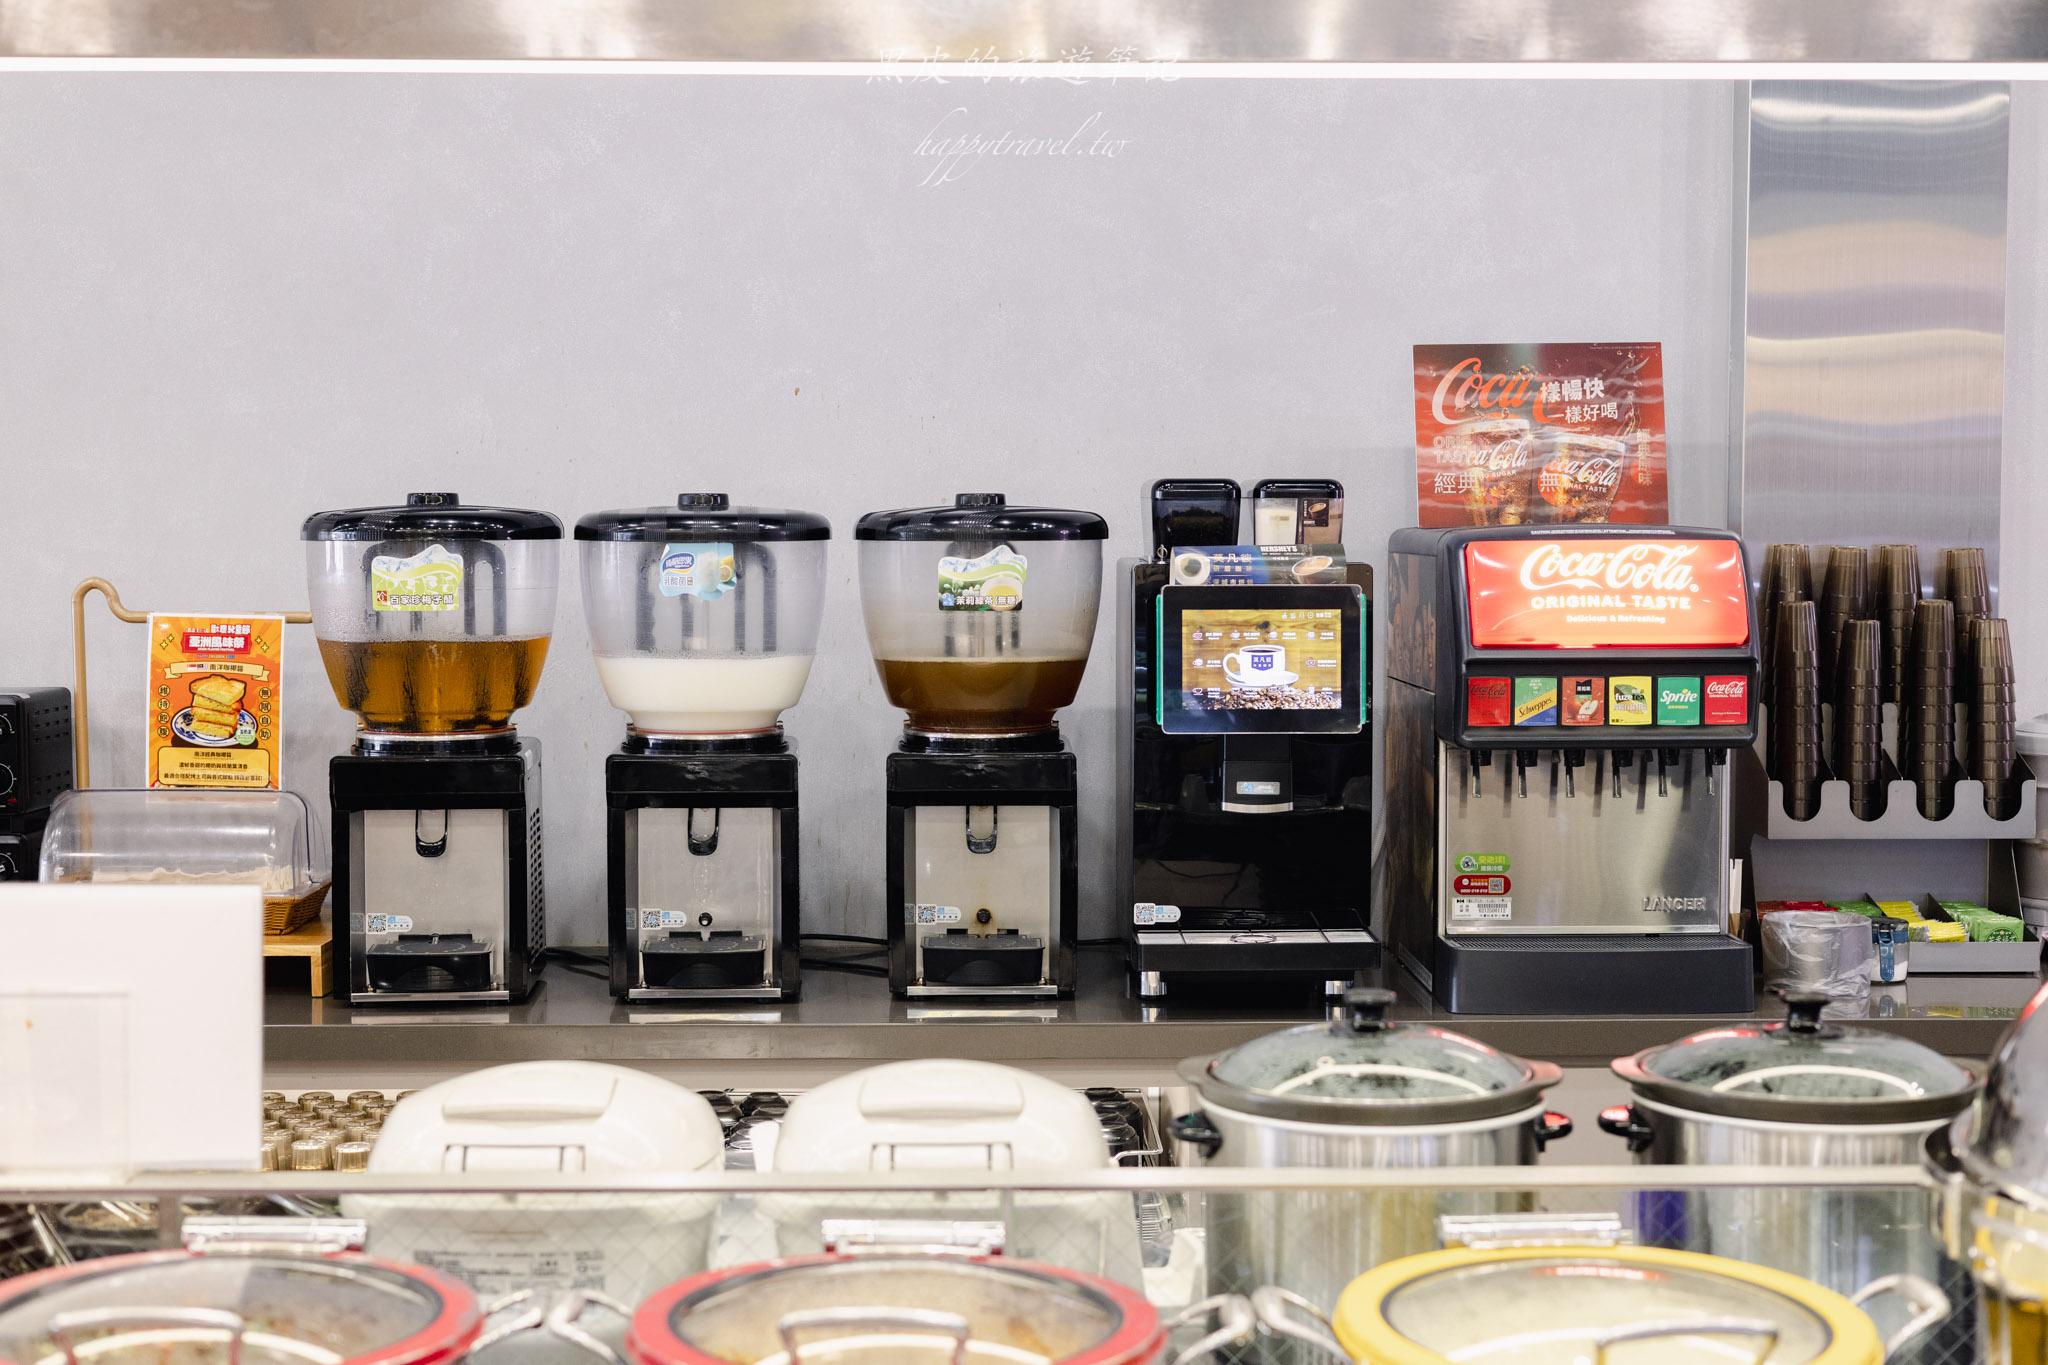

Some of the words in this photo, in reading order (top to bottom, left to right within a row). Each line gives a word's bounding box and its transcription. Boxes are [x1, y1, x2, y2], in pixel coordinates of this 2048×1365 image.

[1547, 402, 1618, 424] 一樣好喝
[1519, 543, 1699, 591] Coca-Cola
[1530, 595, 1626, 610] ORIGINAL
[1631, 594, 1692, 610] TASTE
[1707, 681, 1745, 695] Coca-Cola
[1660, 689, 1698, 705] Sprite
[1518, 697, 1552, 719] Schweppes
[1643, 895, 1707, 912] LANCER
